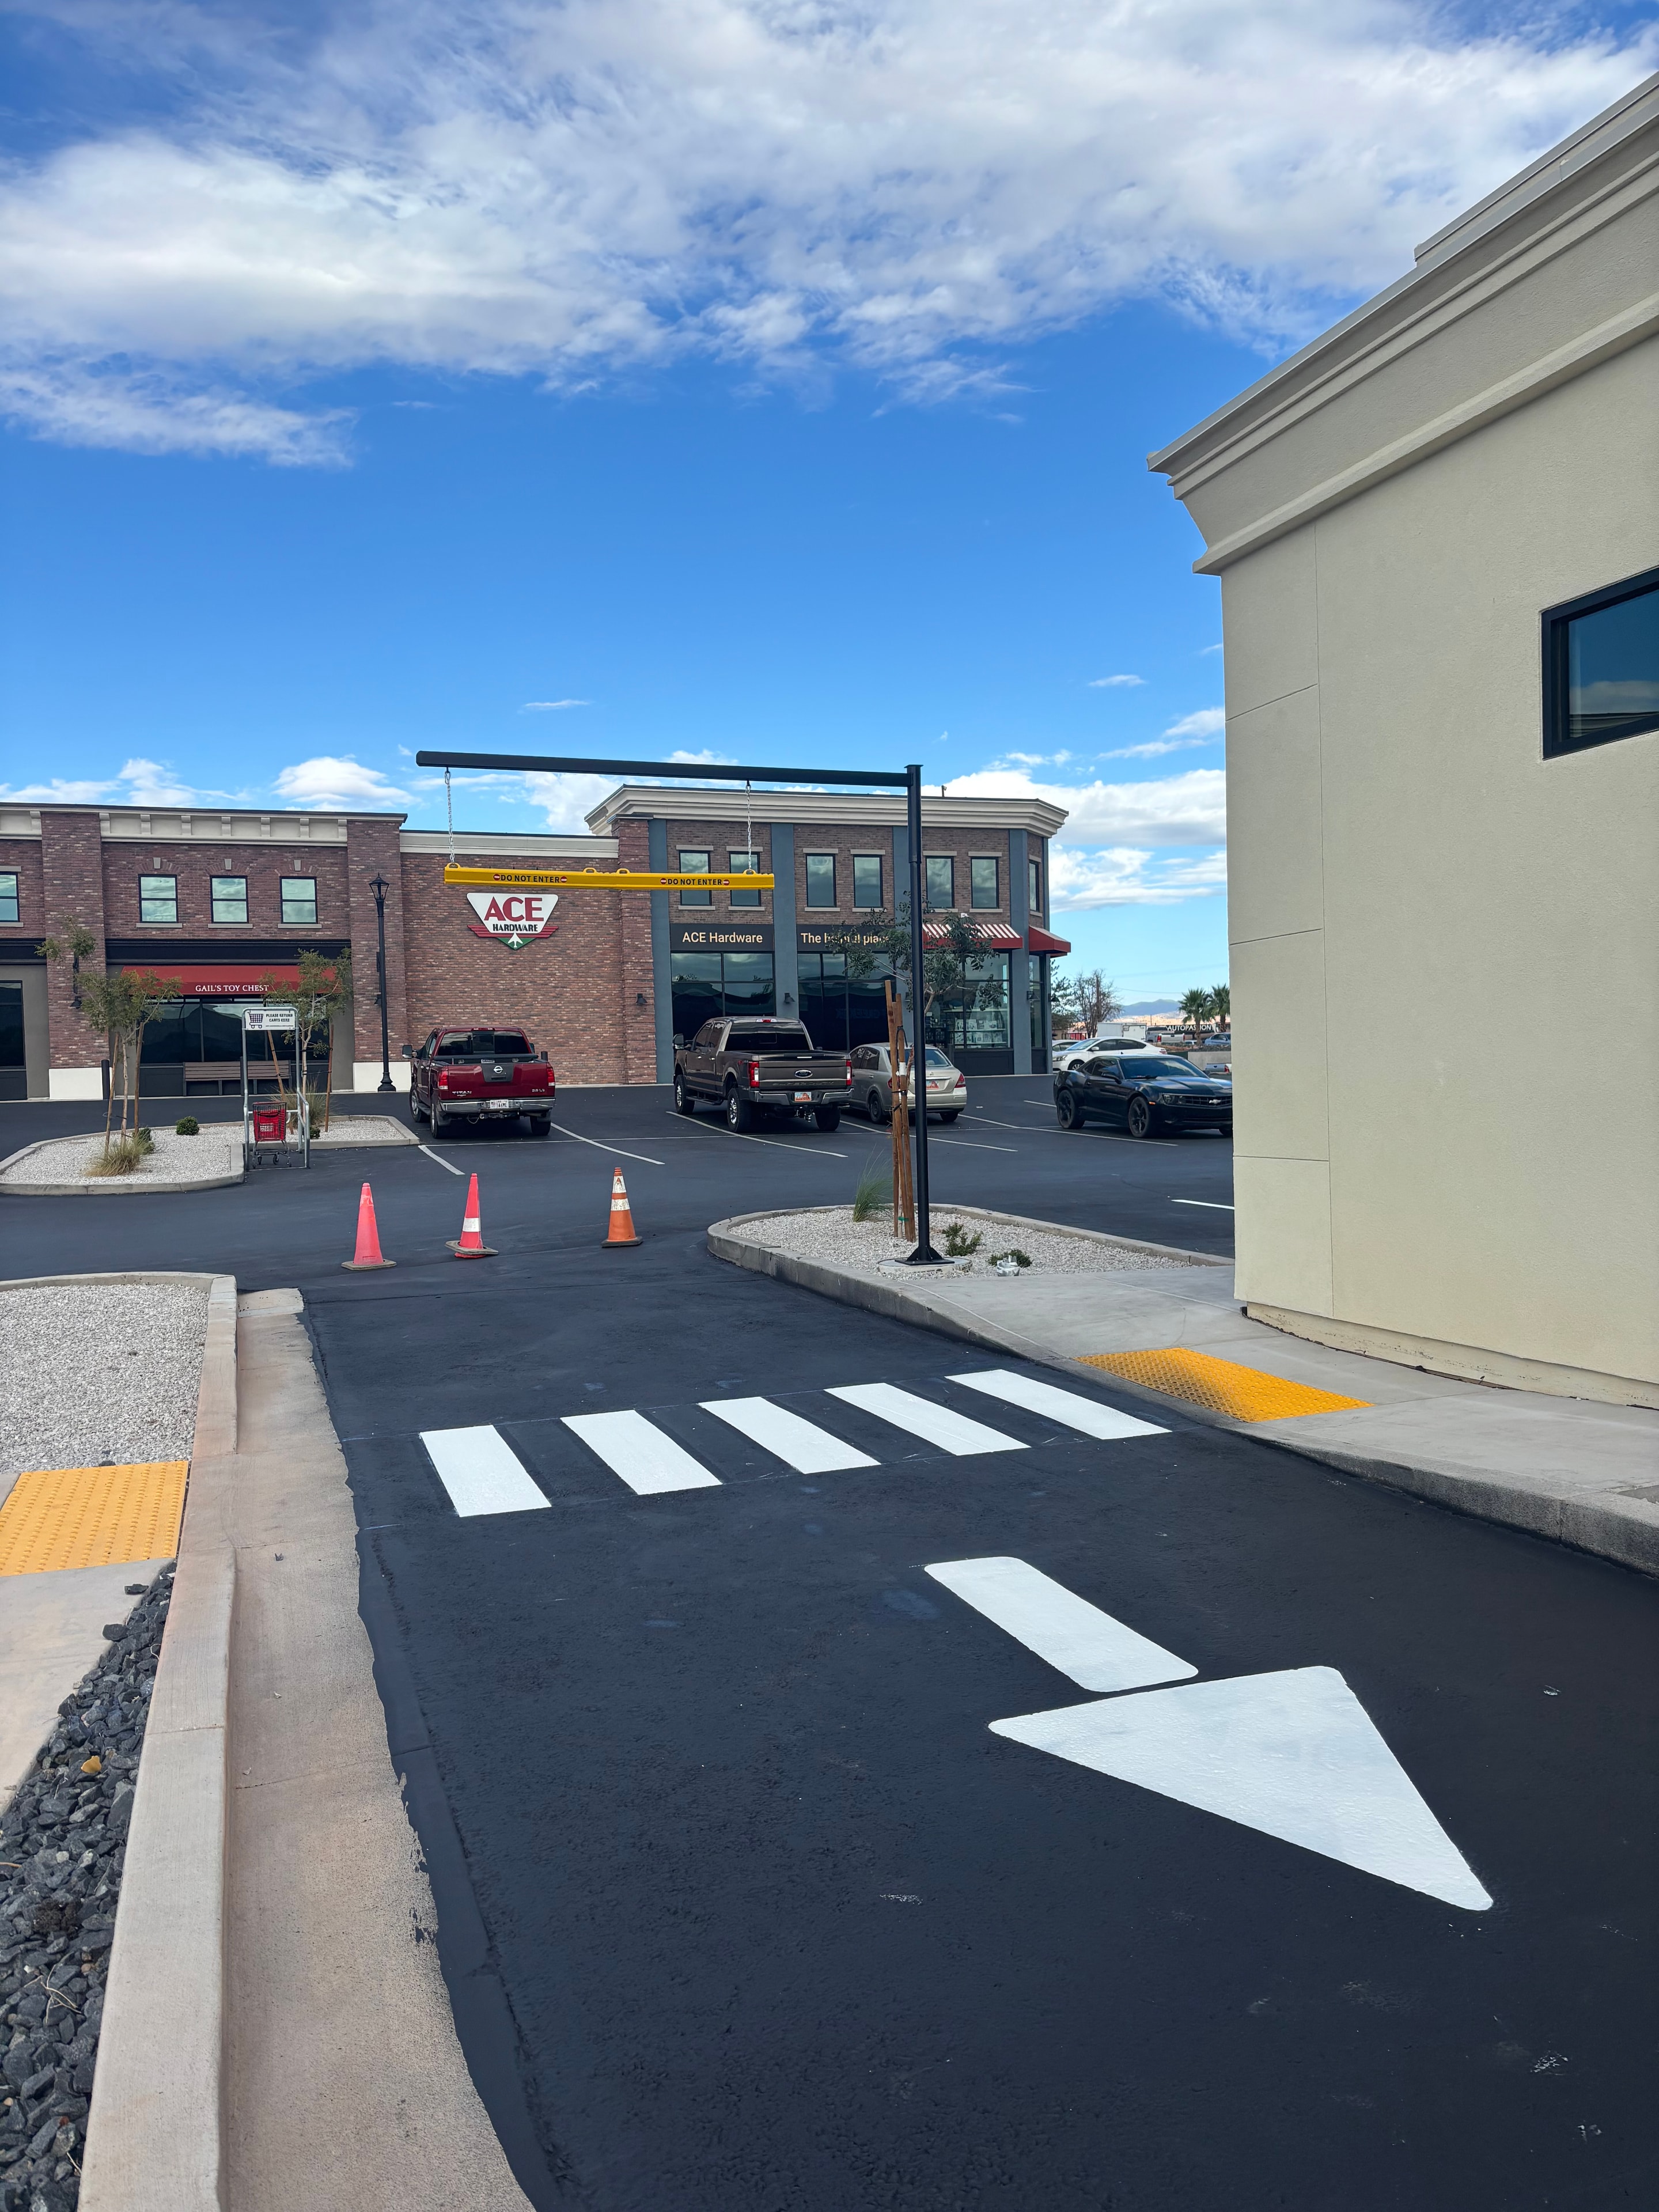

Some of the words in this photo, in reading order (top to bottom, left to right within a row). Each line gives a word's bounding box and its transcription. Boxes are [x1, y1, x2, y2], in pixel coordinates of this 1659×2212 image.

[484, 896, 544, 922] ACE
[493, 923, 538, 932] HARDWARE
[682, 932, 706, 942] ACE
[709, 932, 763, 943] Hardware
[800, 933, 821, 944] The
